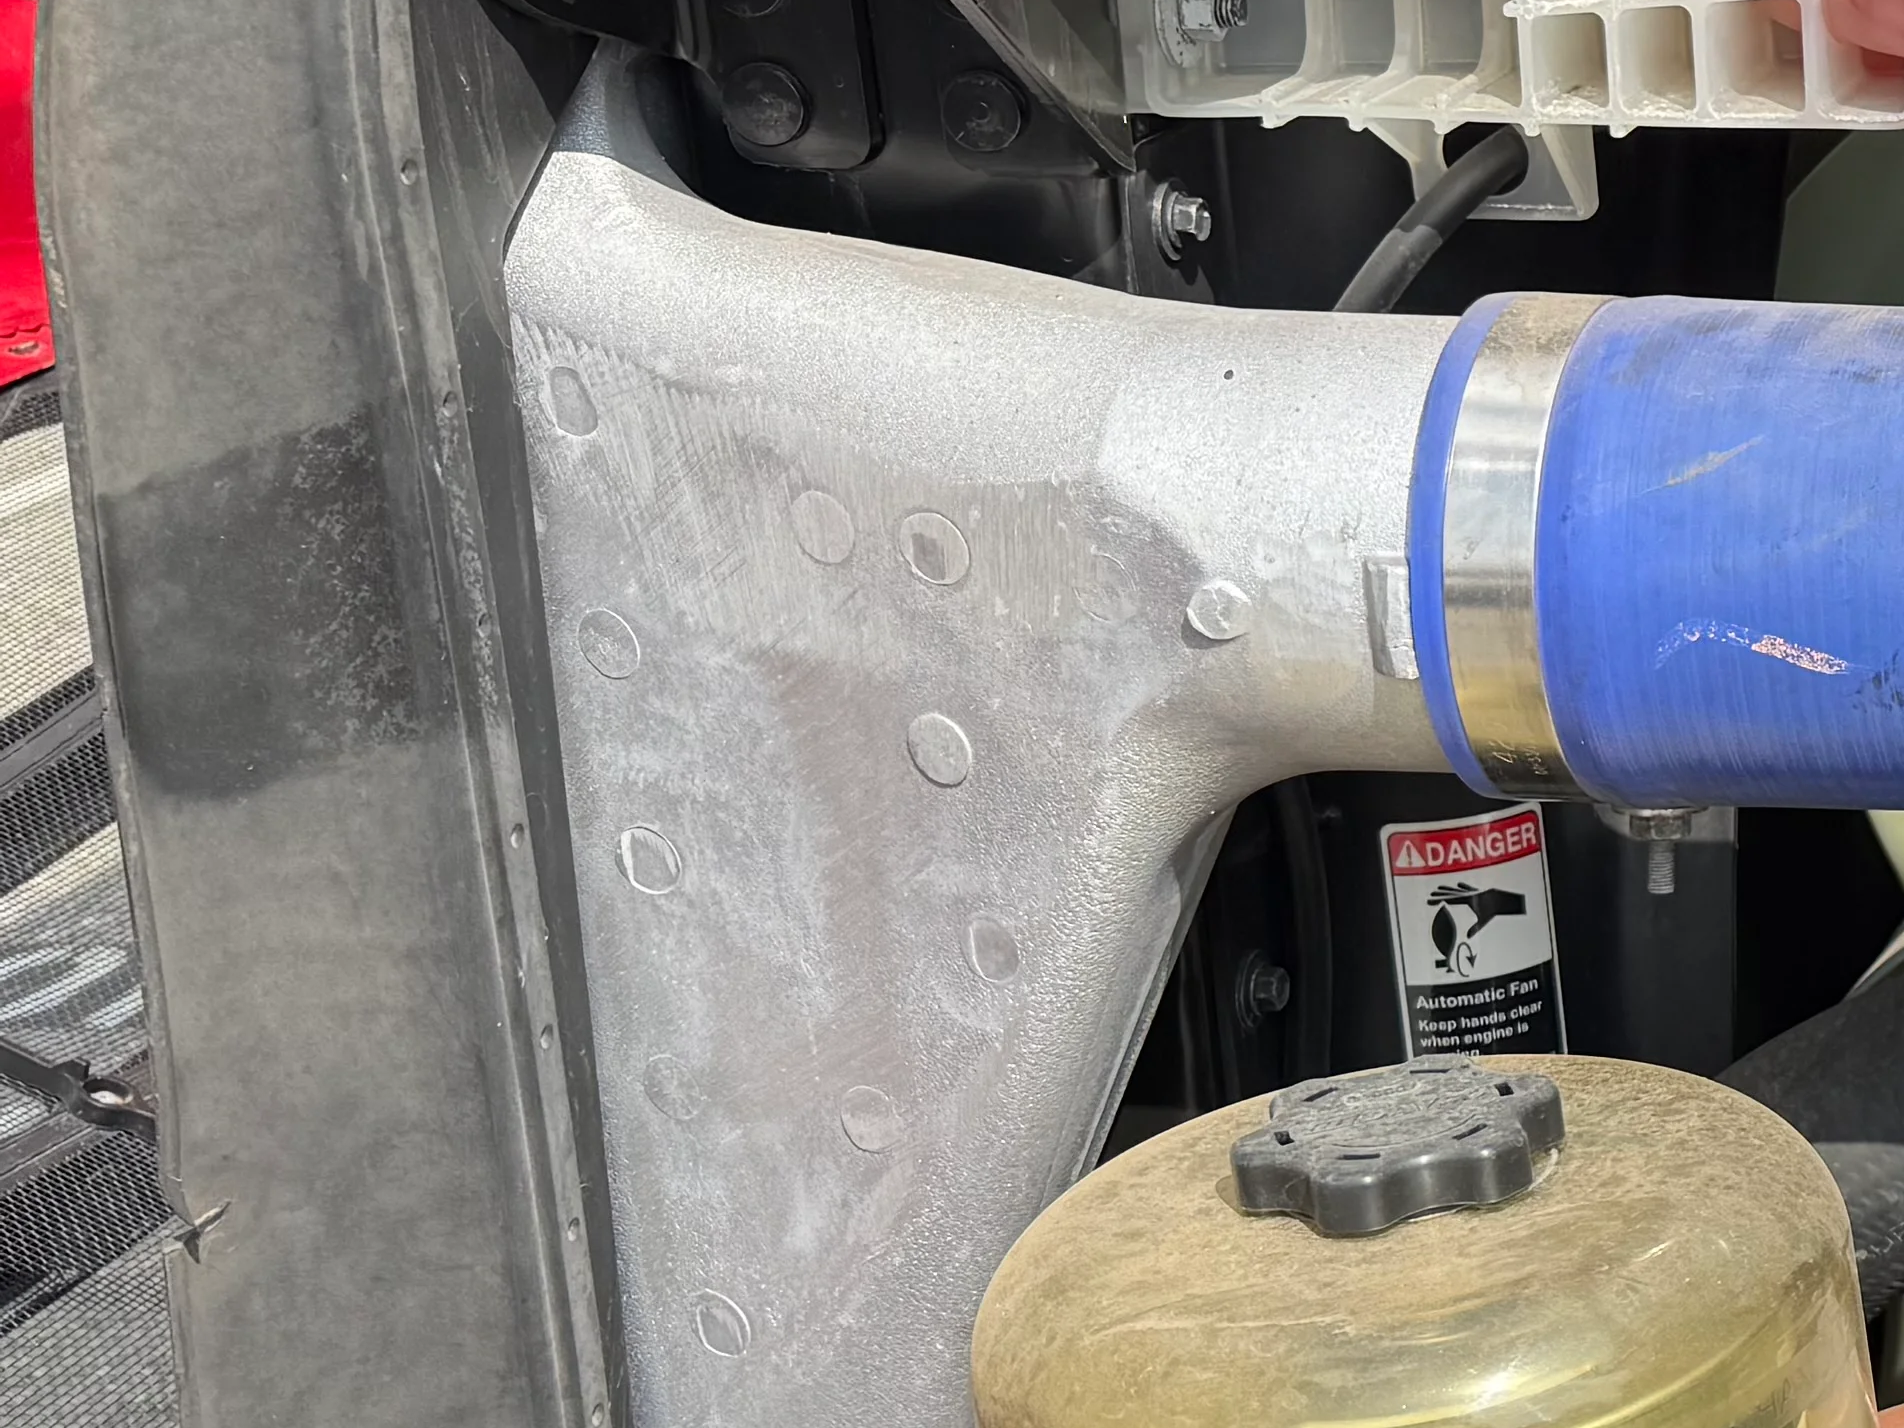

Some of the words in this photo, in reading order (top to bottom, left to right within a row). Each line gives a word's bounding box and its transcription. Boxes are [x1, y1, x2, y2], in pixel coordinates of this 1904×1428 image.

[1426, 821, 1537, 867] DANGER
[1415, 986, 1506, 1010] Automatic
[1510, 977, 1539, 997] Fan
[1418, 1018, 1457, 1033] Keep
[1461, 1011, 1507, 1030] hands
[1510, 1000, 1543, 1020] clear
[1420, 1033, 1460, 1048] when
[1464, 1025, 1514, 1046] engine
[1517, 1021, 1529, 1035] is
